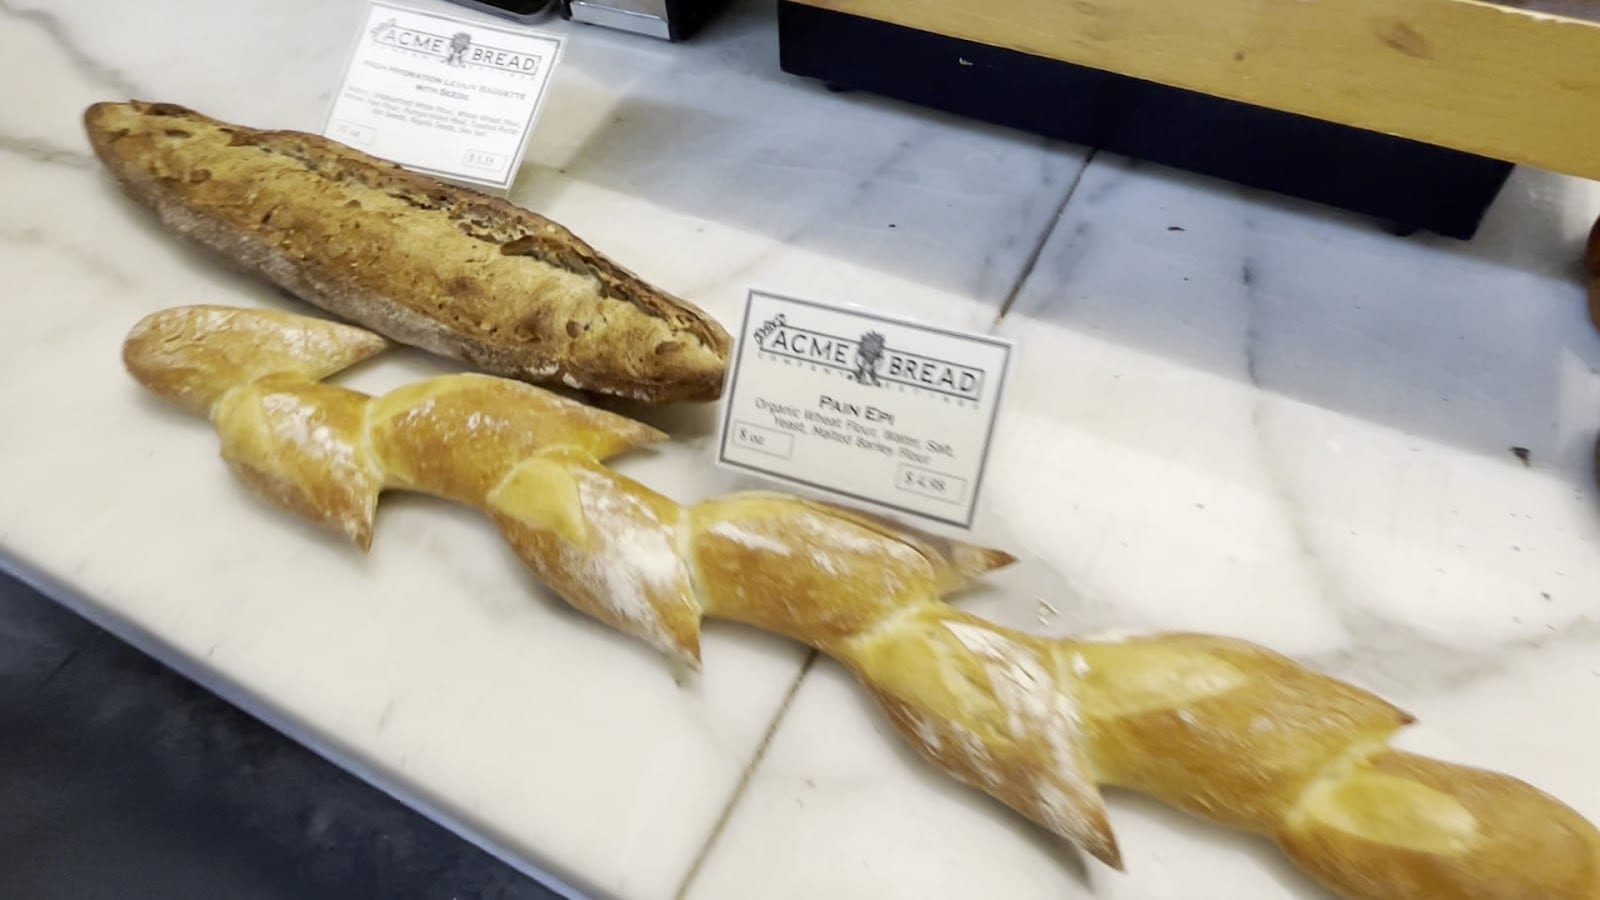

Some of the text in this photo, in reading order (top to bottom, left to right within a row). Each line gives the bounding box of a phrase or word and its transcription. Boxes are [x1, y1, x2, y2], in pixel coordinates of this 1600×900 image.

[384, 29, 443, 52] ACME
[472, 48, 536, 71] BREAD
[478, 84, 526, 101] BAGUETTE
[772, 330, 977, 393] ACME BREAD
[755, 396, 801, 418] Organic
[804, 410, 842, 429] Wheat
[819, 394, 861, 418] PAIN
[864, 405, 896, 427] EPI
[750, 433, 765, 446] oz
[812, 425, 852, 446] Malted
[855, 436, 894, 456] Barley
[899, 447, 932, 466] Flour
